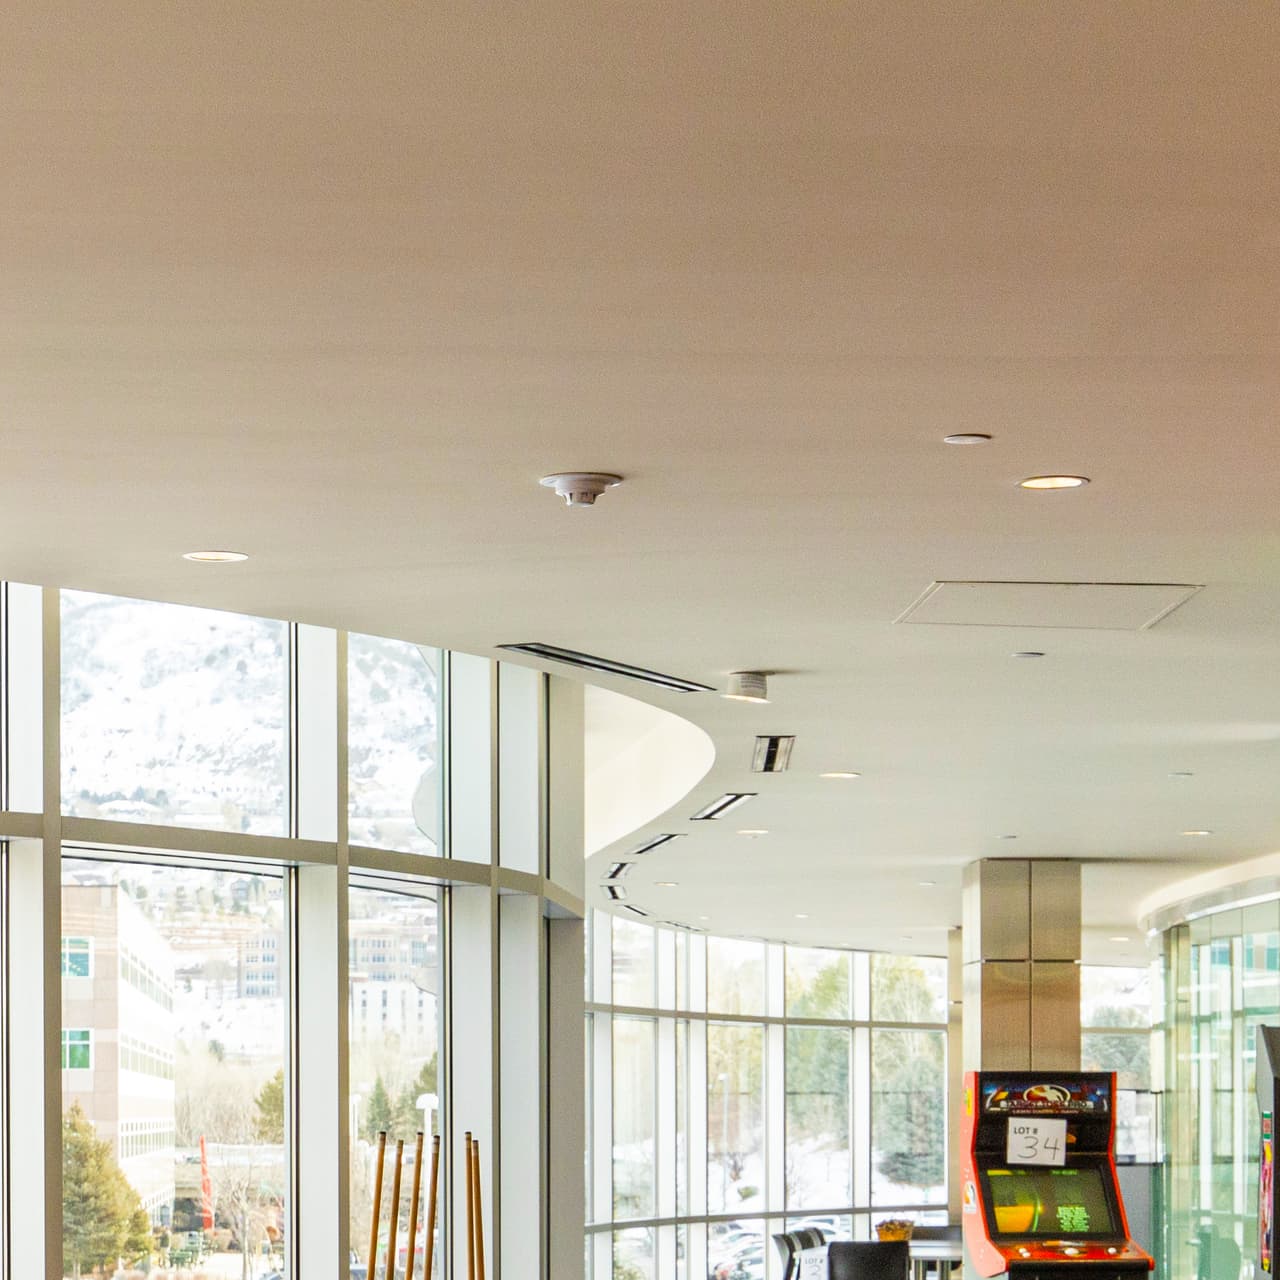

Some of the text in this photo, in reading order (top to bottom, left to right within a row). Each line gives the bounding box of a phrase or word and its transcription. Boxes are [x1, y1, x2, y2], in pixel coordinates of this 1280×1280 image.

[1013, 1126, 1031, 1135] LOT
[1017, 1135, 1061, 1161] 34
[804, 1257, 818, 1265] LOT
